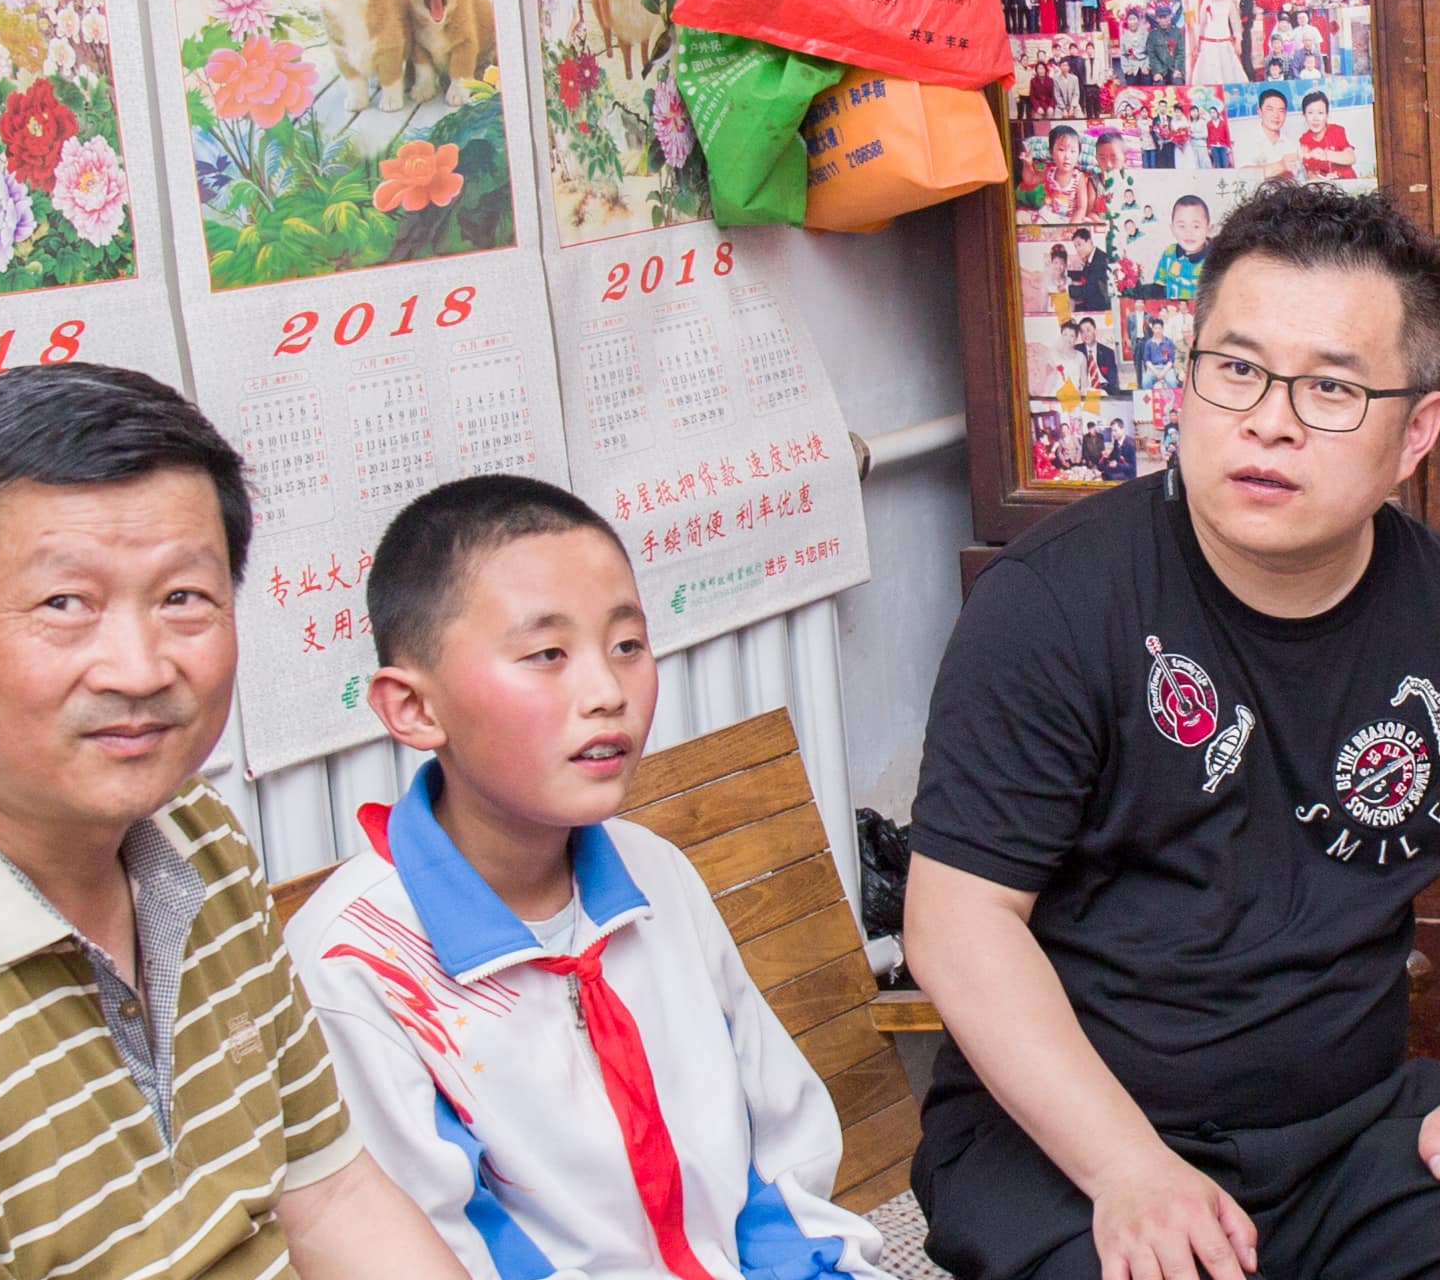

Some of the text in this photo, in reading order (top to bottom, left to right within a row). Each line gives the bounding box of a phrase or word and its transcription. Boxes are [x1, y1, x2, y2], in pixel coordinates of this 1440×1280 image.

[601, 241, 735, 303] 2018
[272, 285, 478, 358] 2018
[613, 431, 831, 521] 房屋抵押贷款 速度快捷
[640, 481, 814, 563] 手续简便 利率优惠
[764, 556, 788, 577] 进步
[793, 537, 841, 567] 与您同行
[1336, 721, 1422, 791] BE THE REASON OF
[1345, 796, 1414, 827] SOMEONE'S
